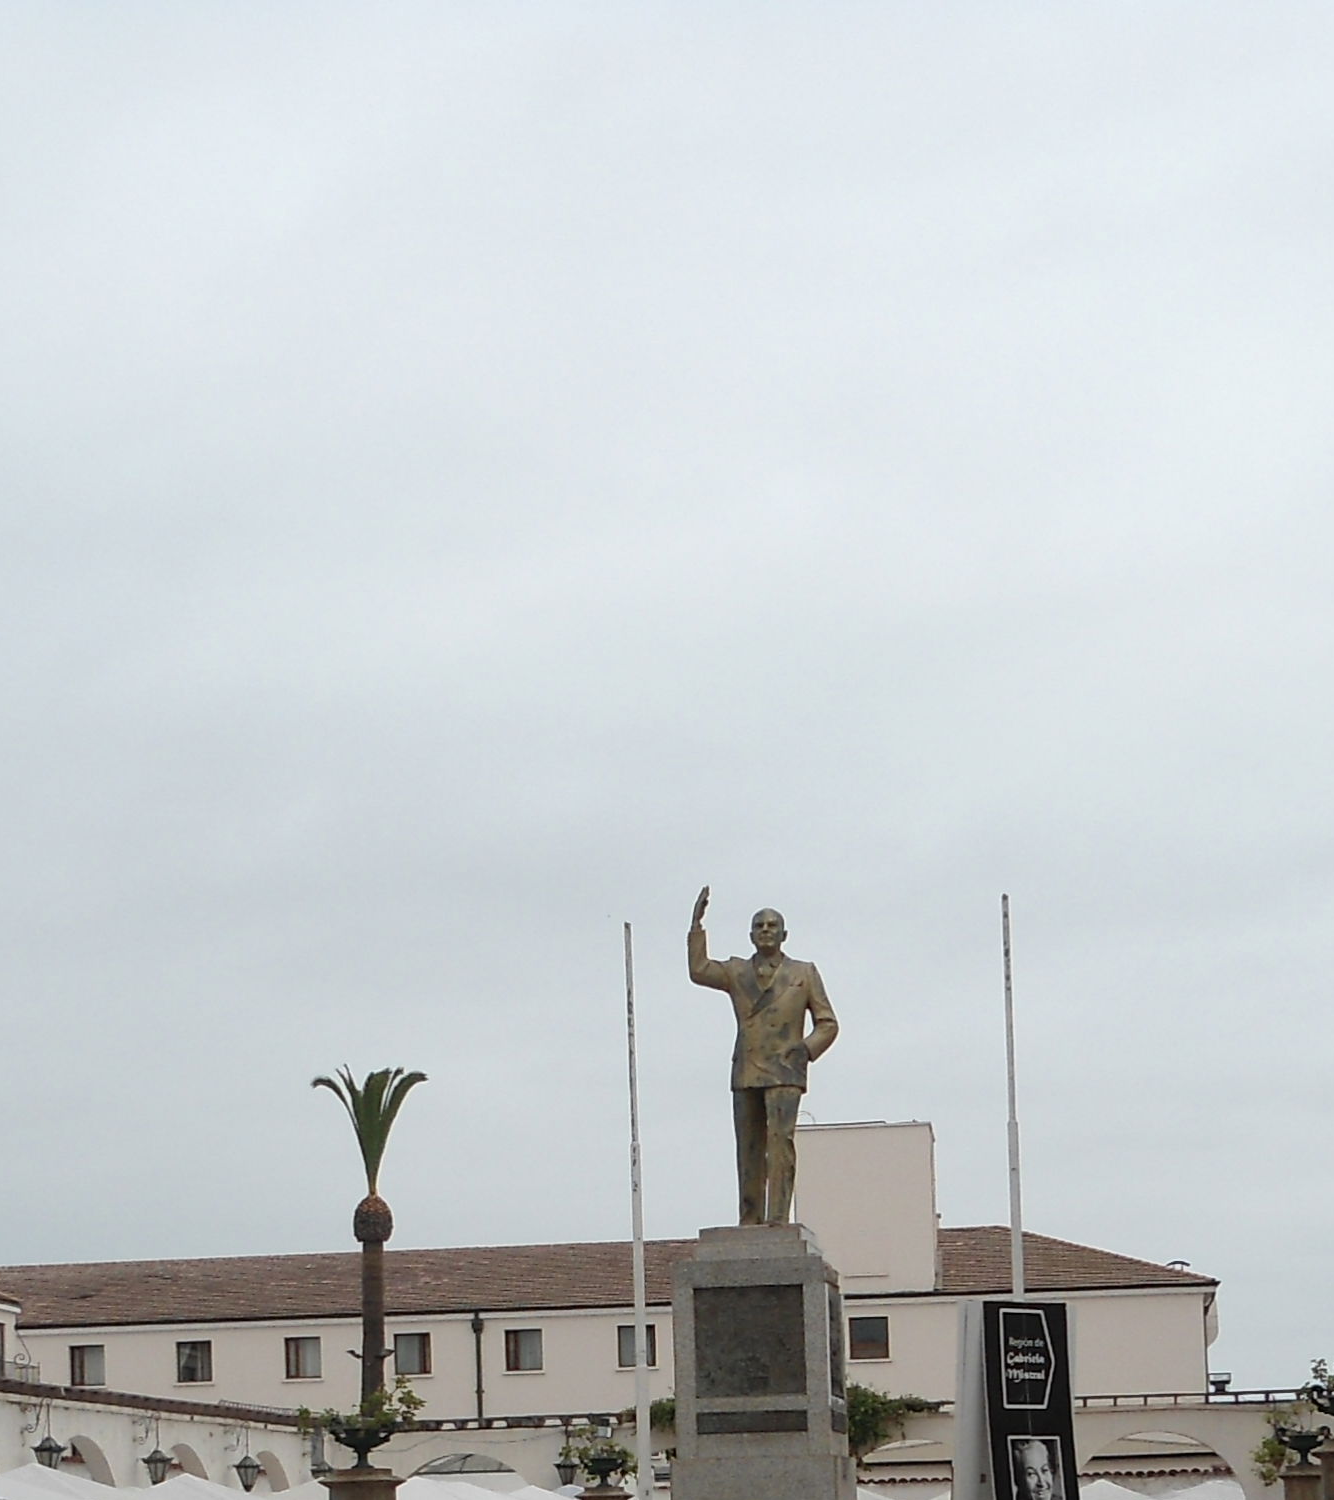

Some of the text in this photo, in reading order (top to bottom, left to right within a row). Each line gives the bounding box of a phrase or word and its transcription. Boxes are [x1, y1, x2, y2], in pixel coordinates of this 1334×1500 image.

[1034, 1337, 1044, 1348] de
[1007, 1352, 1045, 1366] Gabriela
[1006, 1368, 1046, 1382] Mistral
